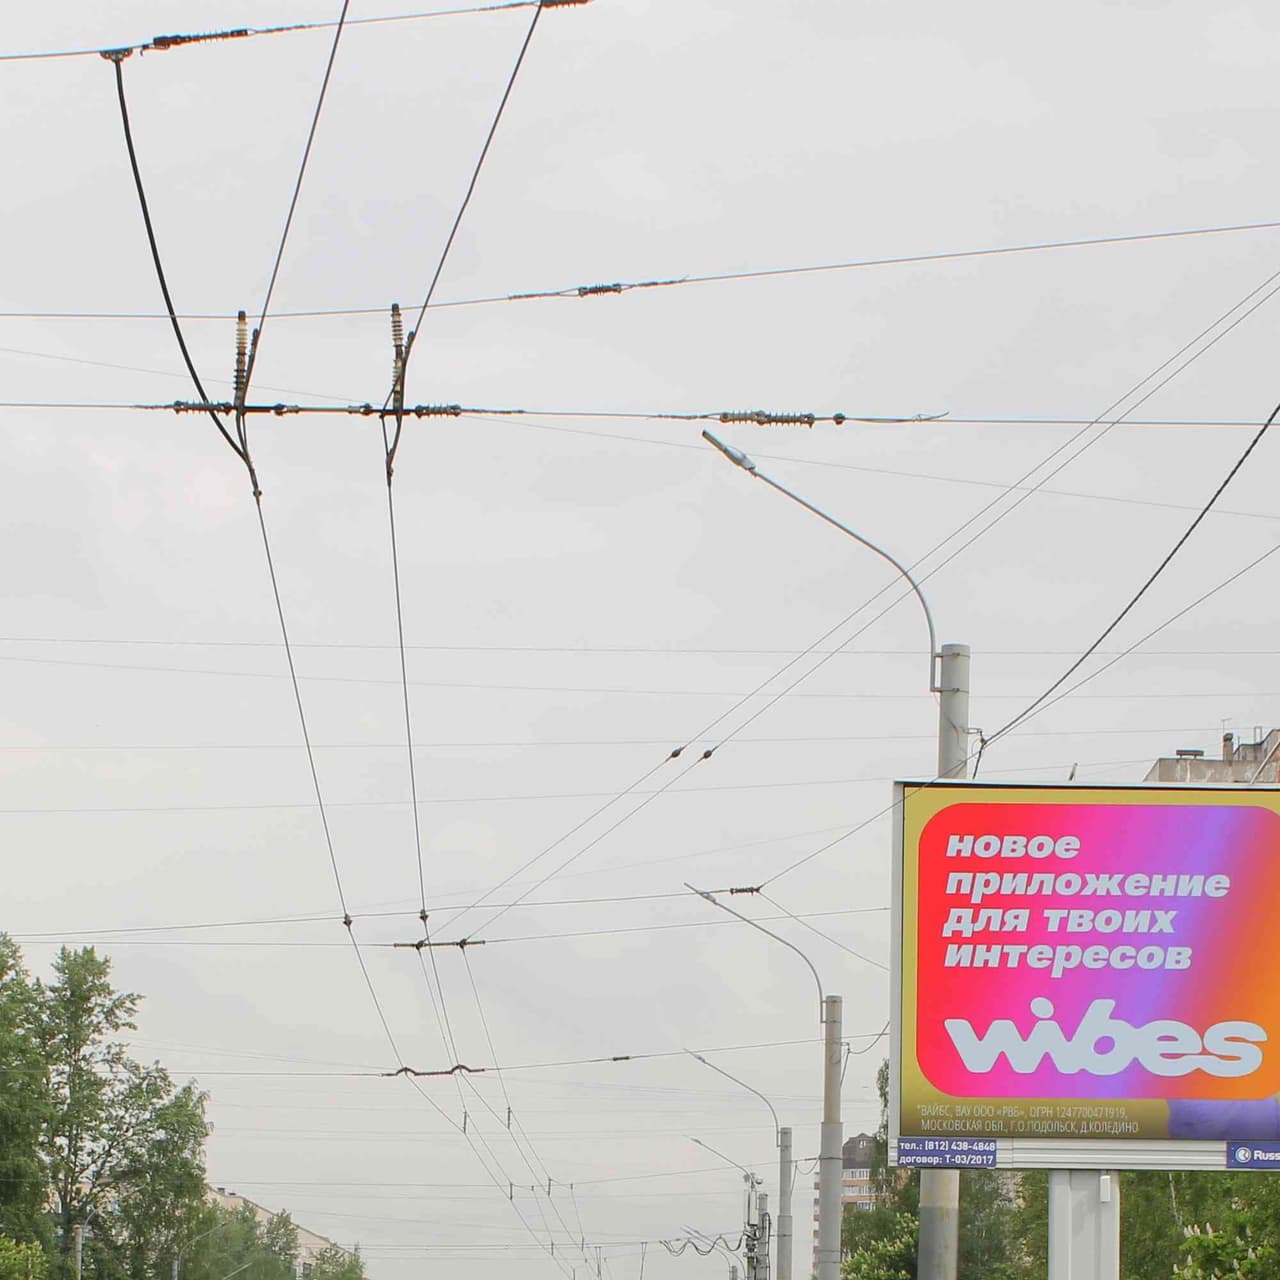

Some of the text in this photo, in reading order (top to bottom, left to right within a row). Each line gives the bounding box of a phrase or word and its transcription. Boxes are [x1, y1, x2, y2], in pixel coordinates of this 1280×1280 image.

[946, 834, 1081, 859] новое
[945, 871, 1231, 904] приложение
[942, 907, 1177, 938] для твоих
[943, 943, 1193, 979] интересов
[944, 996, 1268, 1078] wibes
[921, 1120, 983, 1132] МОСКОВСКАЯ
[900, 1141, 996, 1151] тел.: (812) 438-4848
[900, 1156, 943, 1165] договор:
